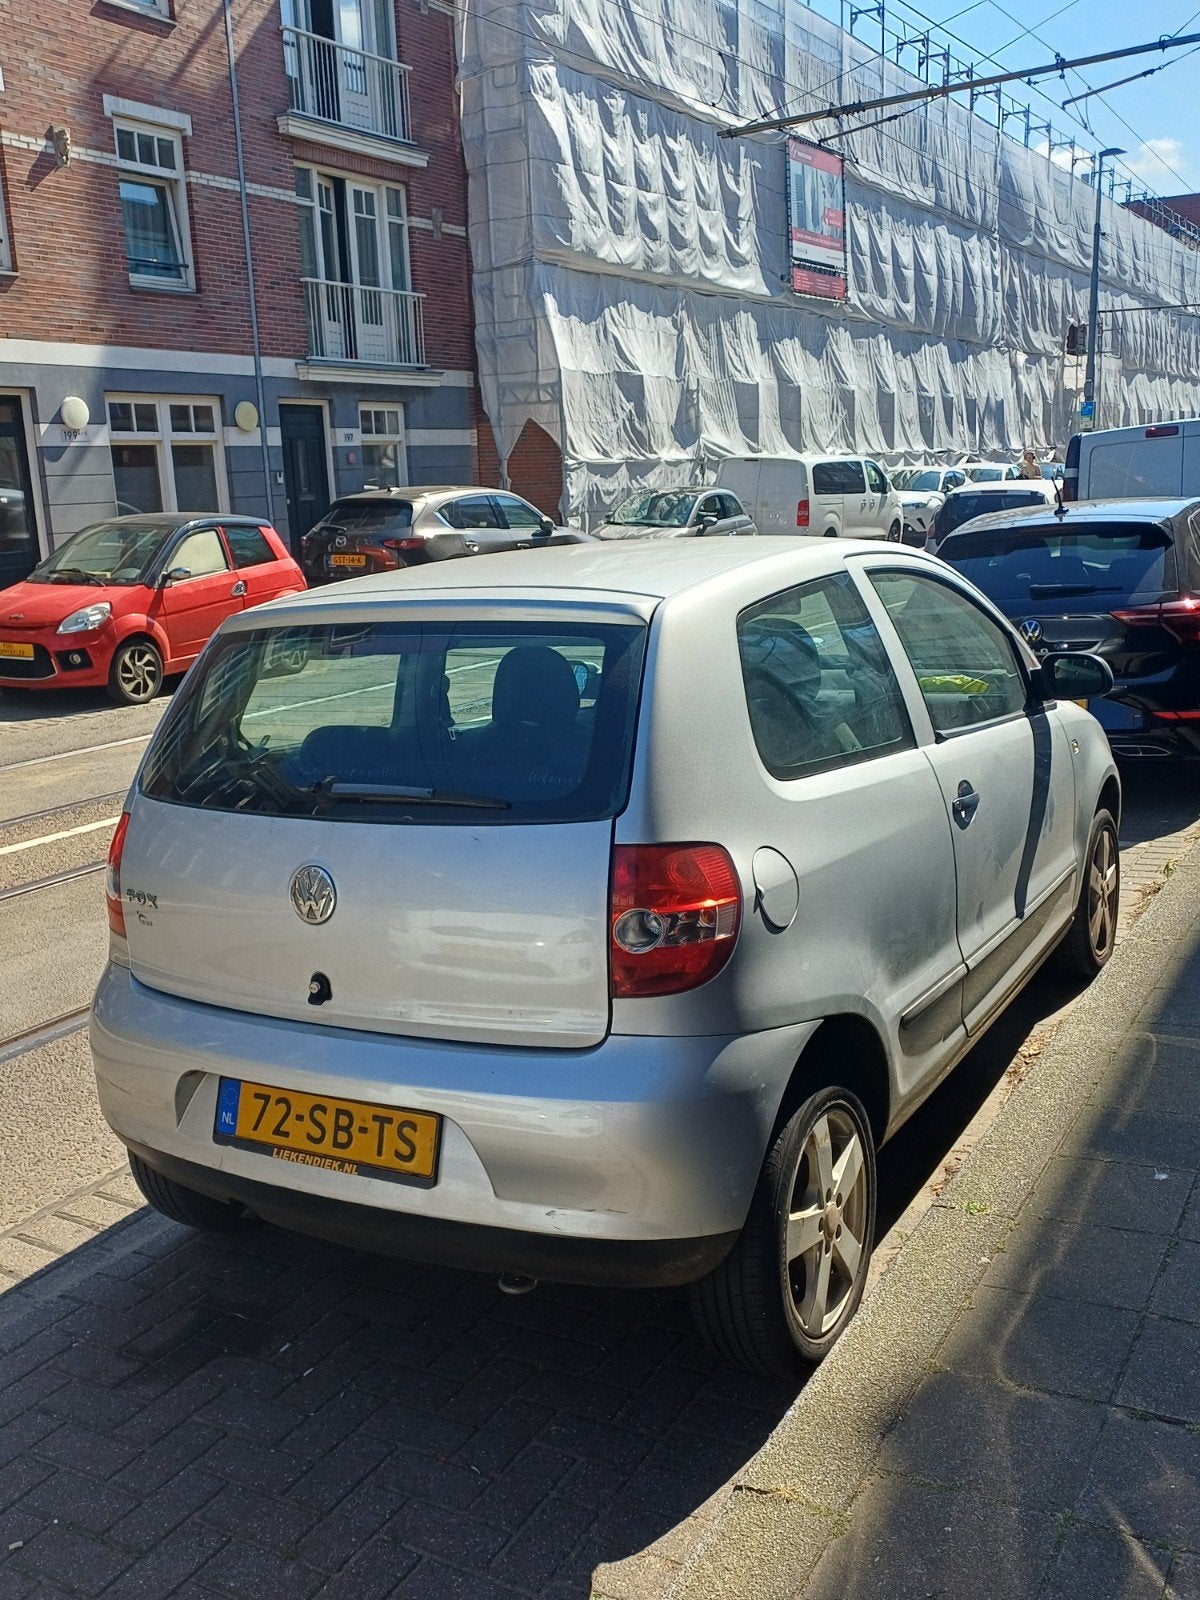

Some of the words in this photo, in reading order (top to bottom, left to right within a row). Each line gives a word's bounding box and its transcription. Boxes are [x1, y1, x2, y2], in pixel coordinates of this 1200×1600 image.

[221, 1110, 235, 1126] NL
[251, 1092, 418, 1164] 72-SB-TS
[272, 1147, 359, 1176] LIEKENDIEK.NL
